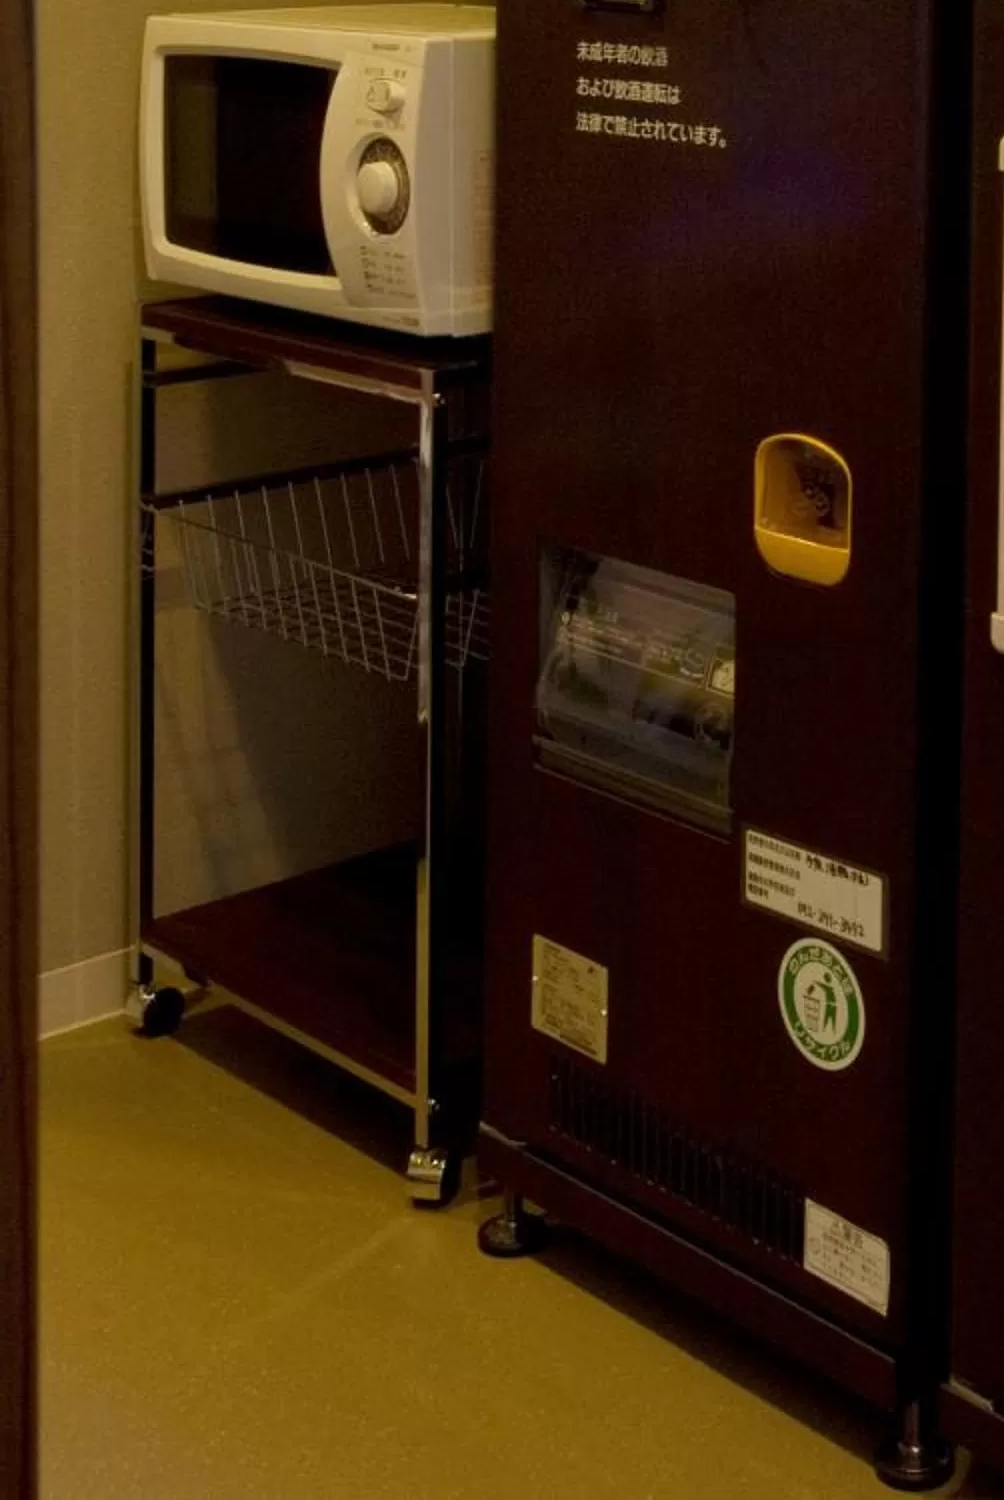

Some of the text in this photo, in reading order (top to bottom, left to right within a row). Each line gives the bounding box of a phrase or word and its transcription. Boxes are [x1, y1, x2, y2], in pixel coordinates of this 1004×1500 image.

[576, 111, 727, 148] 法律で禁止されています。
